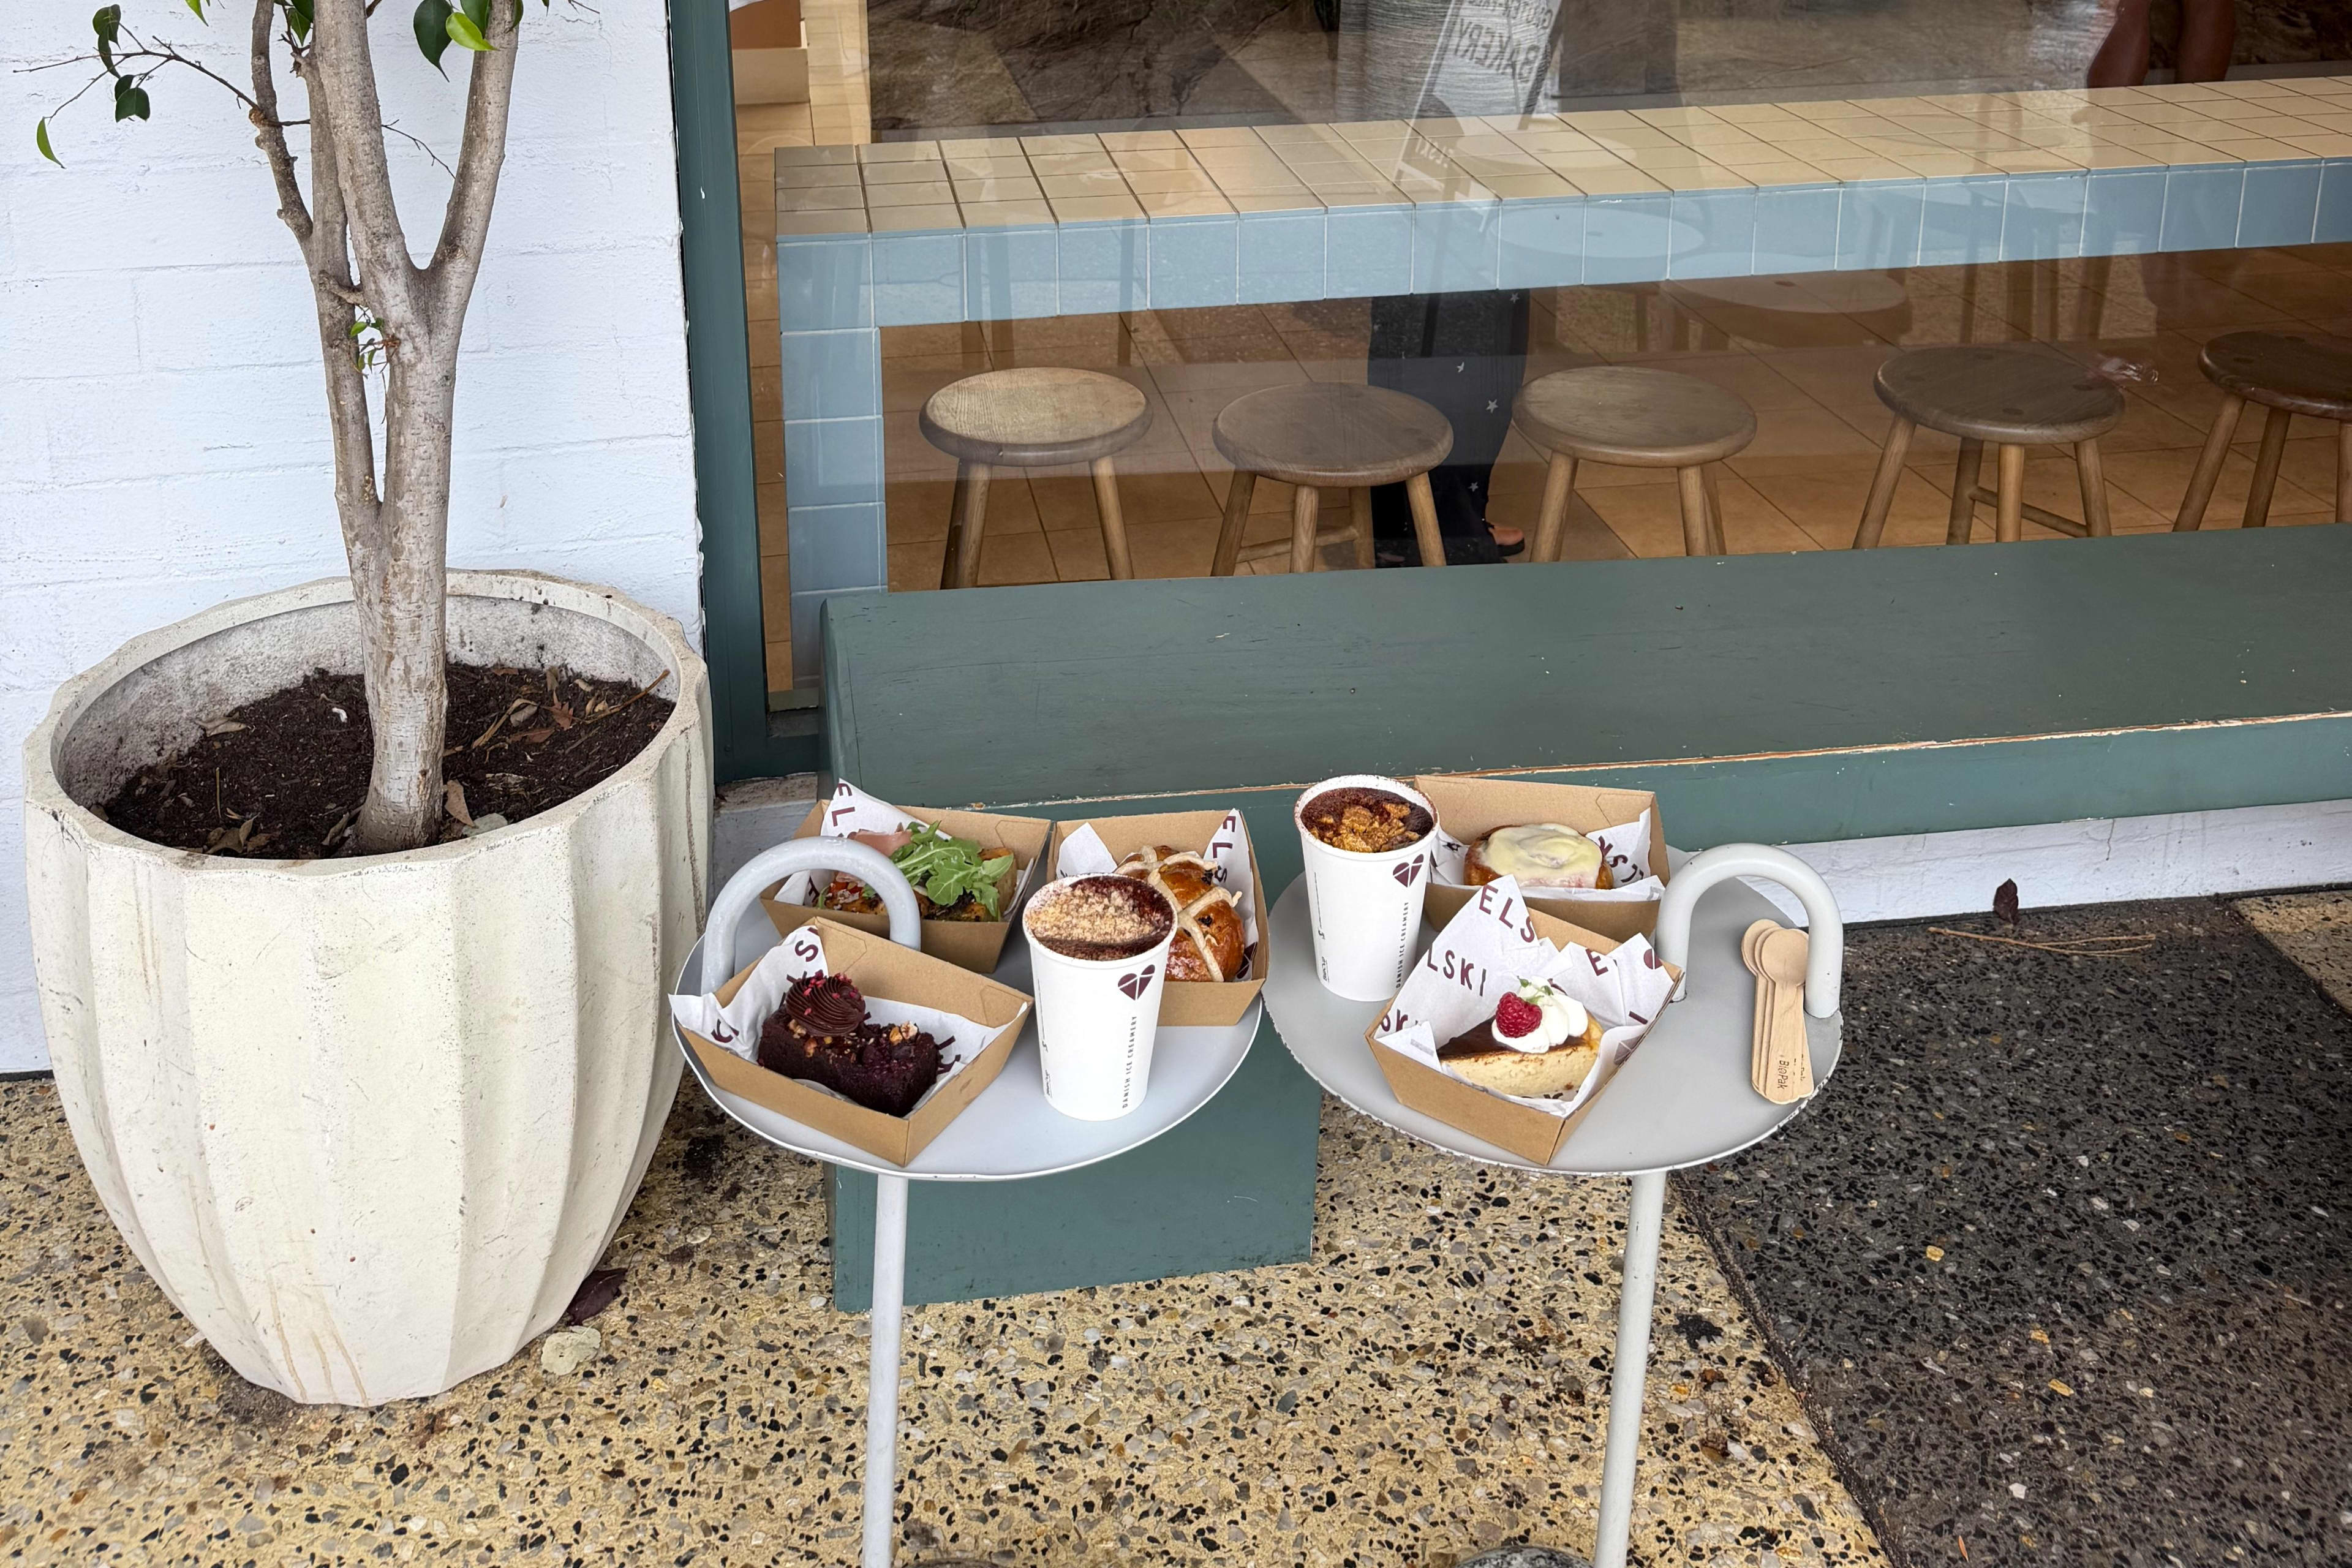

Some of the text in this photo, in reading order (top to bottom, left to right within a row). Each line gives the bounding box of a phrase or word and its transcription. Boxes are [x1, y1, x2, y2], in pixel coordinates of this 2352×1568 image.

[831, 783, 856, 837] EL
[1400, 902, 1409, 941] CREAMERY
[1427, 949, 1487, 997] LSKI
[1122, 1077, 1131, 1109] DANISH
[1127, 1016, 1137, 1058] CREAMERY
